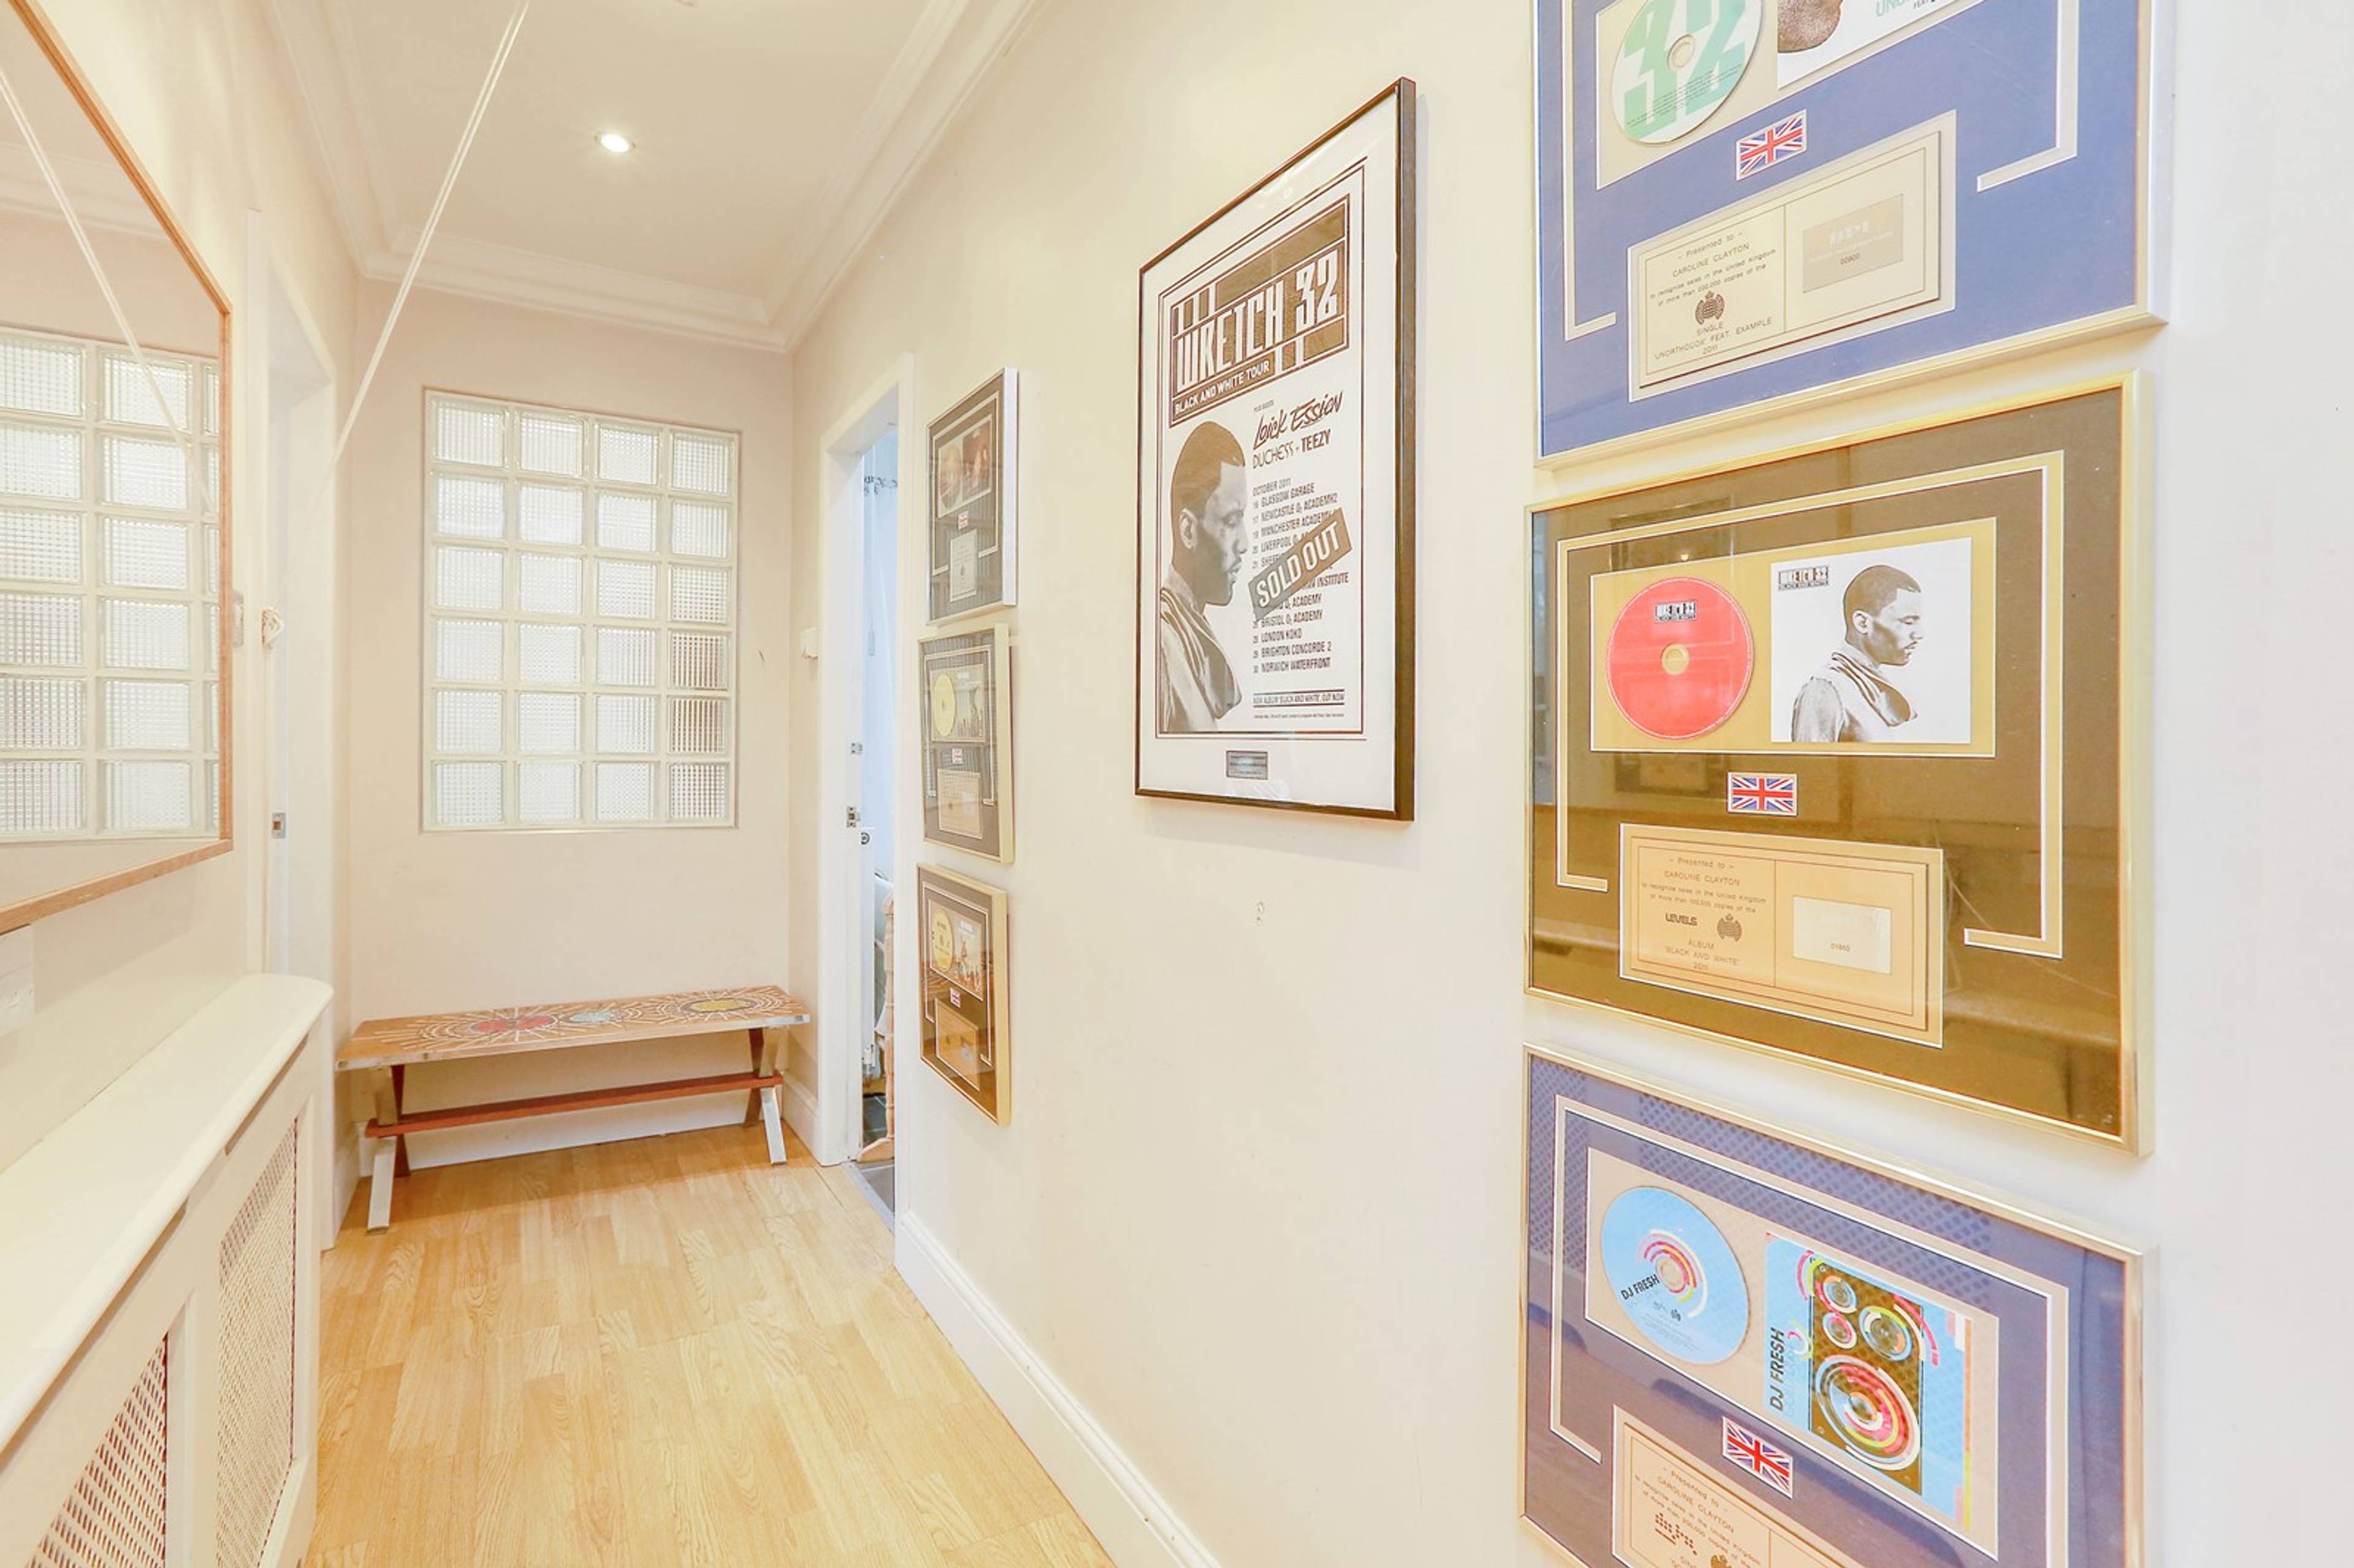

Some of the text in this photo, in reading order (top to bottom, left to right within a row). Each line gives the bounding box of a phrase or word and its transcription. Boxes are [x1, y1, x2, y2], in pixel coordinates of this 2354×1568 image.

[1686, 238, 1723, 257] Presented
[1748, 249, 1776, 262] Kingdom
[1672, 243, 1750, 277] CAROLINE CLAYTON
[1176, 248, 1339, 393] WRETCH 32
[1697, 322, 1723, 336] SINGLE
[1736, 316, 1772, 335] EXAMPLE
[1702, 344, 1718, 355] 2011
[1174, 360, 1270, 415] BLACK AND WHITE TOUR
[1252, 428, 1331, 470] DUCHESS TEEZY
[1252, 480, 1278, 497] OCTOBER
[1261, 490, 1290, 508] GLASGOW
[1290, 482, 1315, 499] GARAGE
[1261, 504, 1295, 522] NEWCASTLE
[1261, 517, 1300, 537] MANCHESTER
[1261, 536, 1292, 553] LIVERPOOL
[1256, 520, 1340, 607] SOLD OUT
[1317, 571, 1349, 590] INSTITUTE
[1292, 593, 1322, 607] ACADEMY
[1261, 614, 1286, 628] BRISTOL
[1293, 609, 1323, 624] ACADEMY
[1261, 629, 1285, 643] LONDON
[1286, 627, 1303, 640] KOKO
[1261, 645, 1290, 659] BRIGHTON
[1292, 641, 1325, 657] CONCORDE
[1327, 641, 1332, 652] 2
[1261, 660, 1289, 673] NORWICH
[1290, 657, 1331, 671] WATERFRONT
[1677, 857, 1713, 868] Presented
[1664, 870, 1740, 886] CAROLINE CLAYTON
[1738, 895, 1767, 905] Kingdom
[1665, 912, 1698, 927] LEVELS
[1688, 938, 1715, 950] ALBUM
[1693, 951, 1710, 961] AND
[1693, 962, 1710, 972] 2011
[1620, 1286, 1634, 1300] DJ
[1632, 1273, 1661, 1295] FRESH
[1770, 1326, 1785, 1412] DJ FRESH
[1671, 1471, 1707, 1499] Presented
[1658, 1476, 1734, 1533] CAROLINE CLAYTON
[1733, 1543, 1761, 1565] Kingdom
